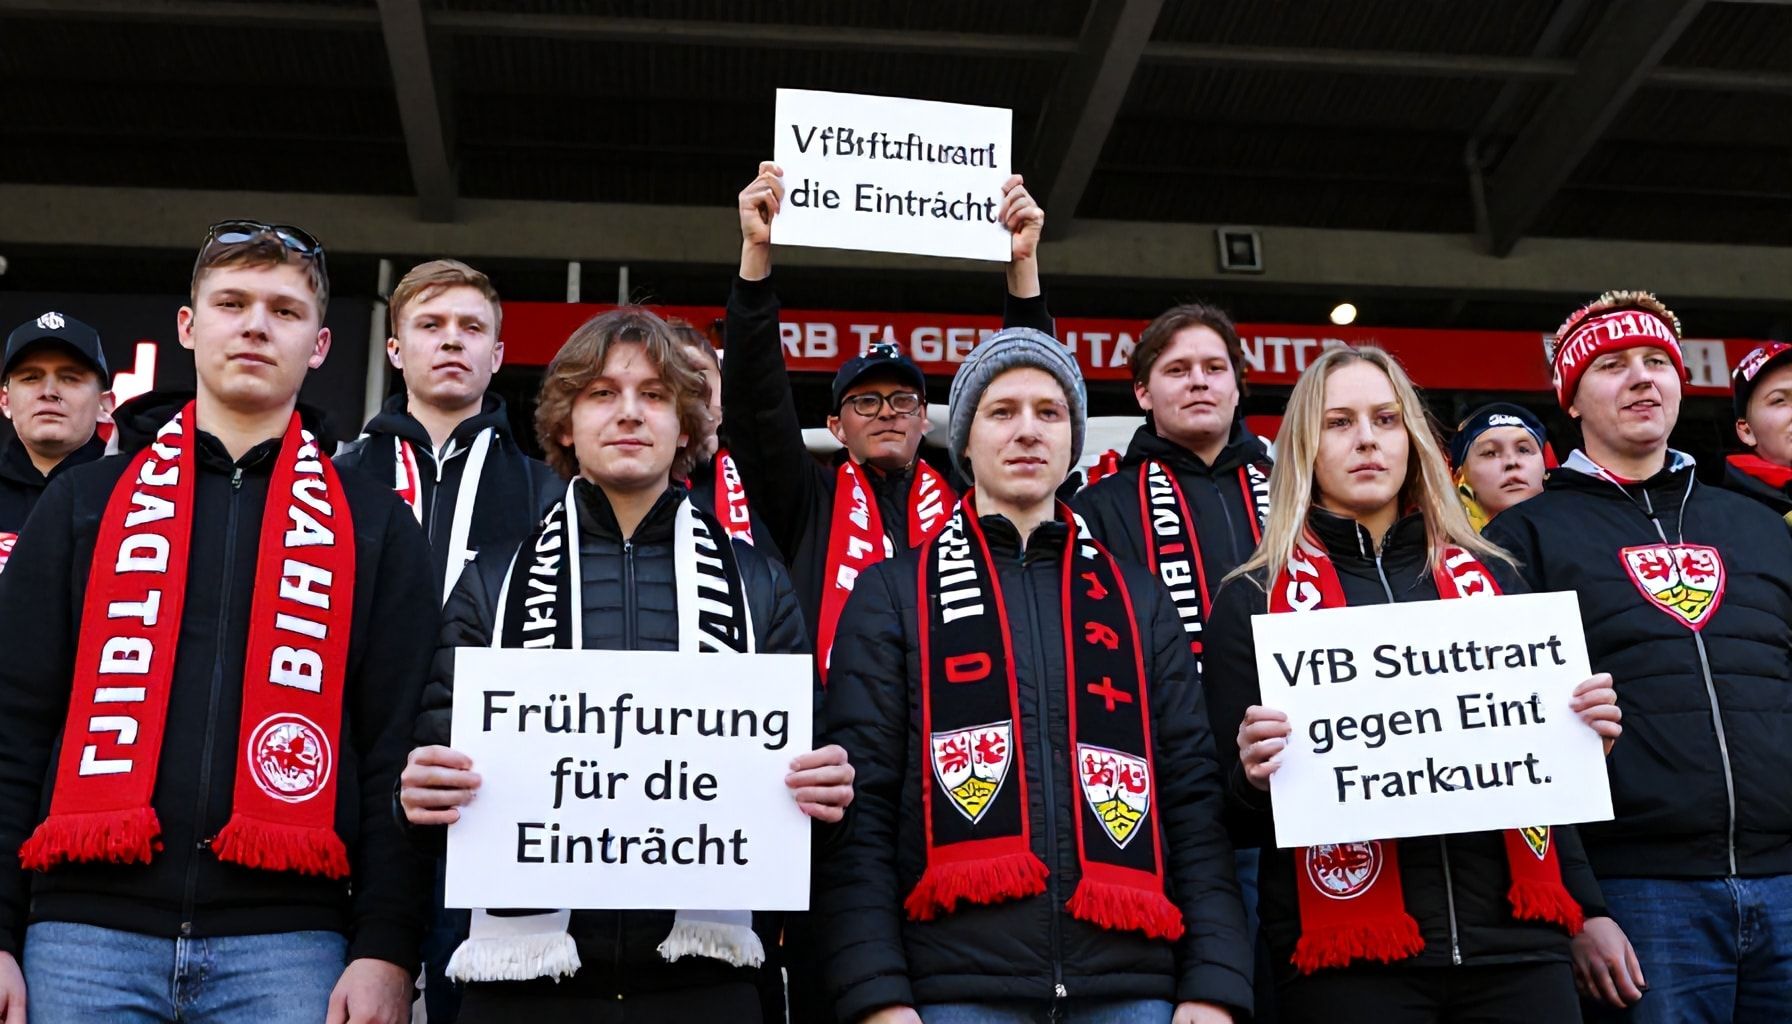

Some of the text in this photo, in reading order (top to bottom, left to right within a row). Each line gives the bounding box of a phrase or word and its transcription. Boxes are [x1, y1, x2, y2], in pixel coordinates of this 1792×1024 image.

[790, 178, 840, 209] die
[1272, 635, 1566, 687] VfB Stuttrart
[482, 690, 789, 751] Frühfurung
[1308, 692, 1546, 754] gegen Eint
[550, 756, 718, 810] für die
[516, 822, 749, 866] Einträcht
